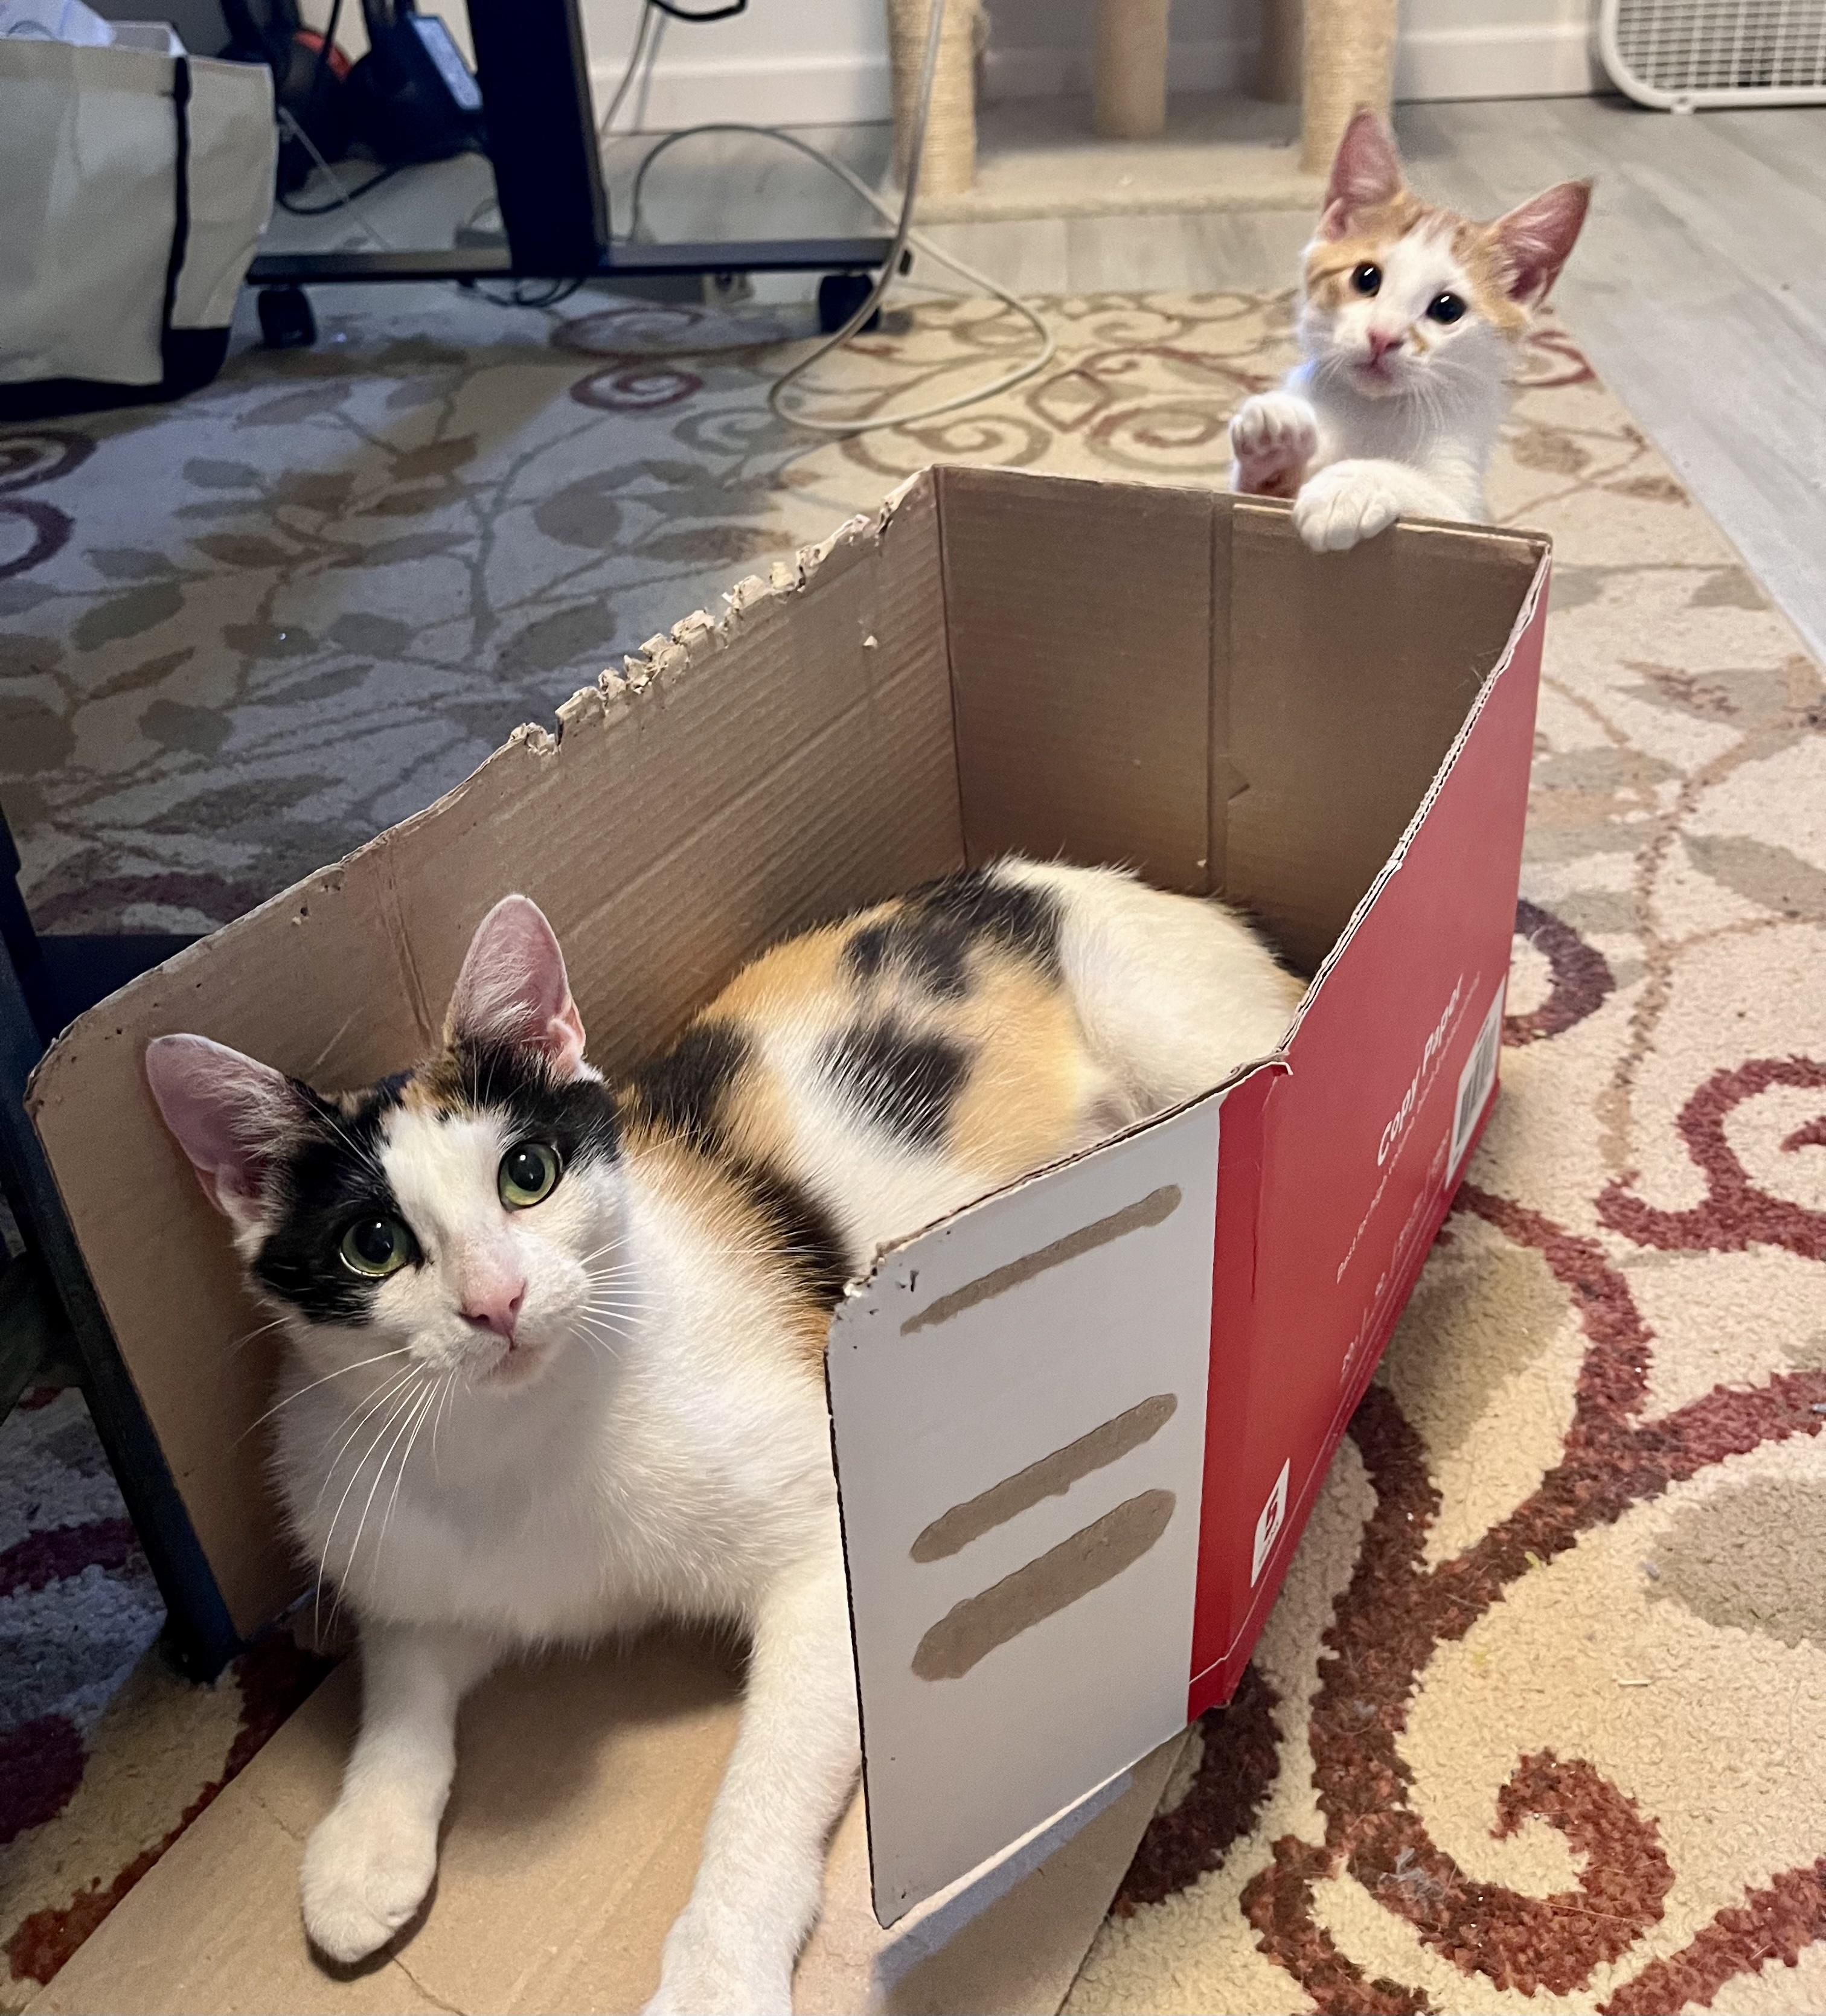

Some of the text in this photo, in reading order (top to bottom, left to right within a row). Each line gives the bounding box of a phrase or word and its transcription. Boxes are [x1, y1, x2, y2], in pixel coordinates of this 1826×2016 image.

[1377, 1065, 1420, 1166] Copy
[1422, 973, 1463, 1077] Paper
[1264, 1487, 1278, 1542] 5
